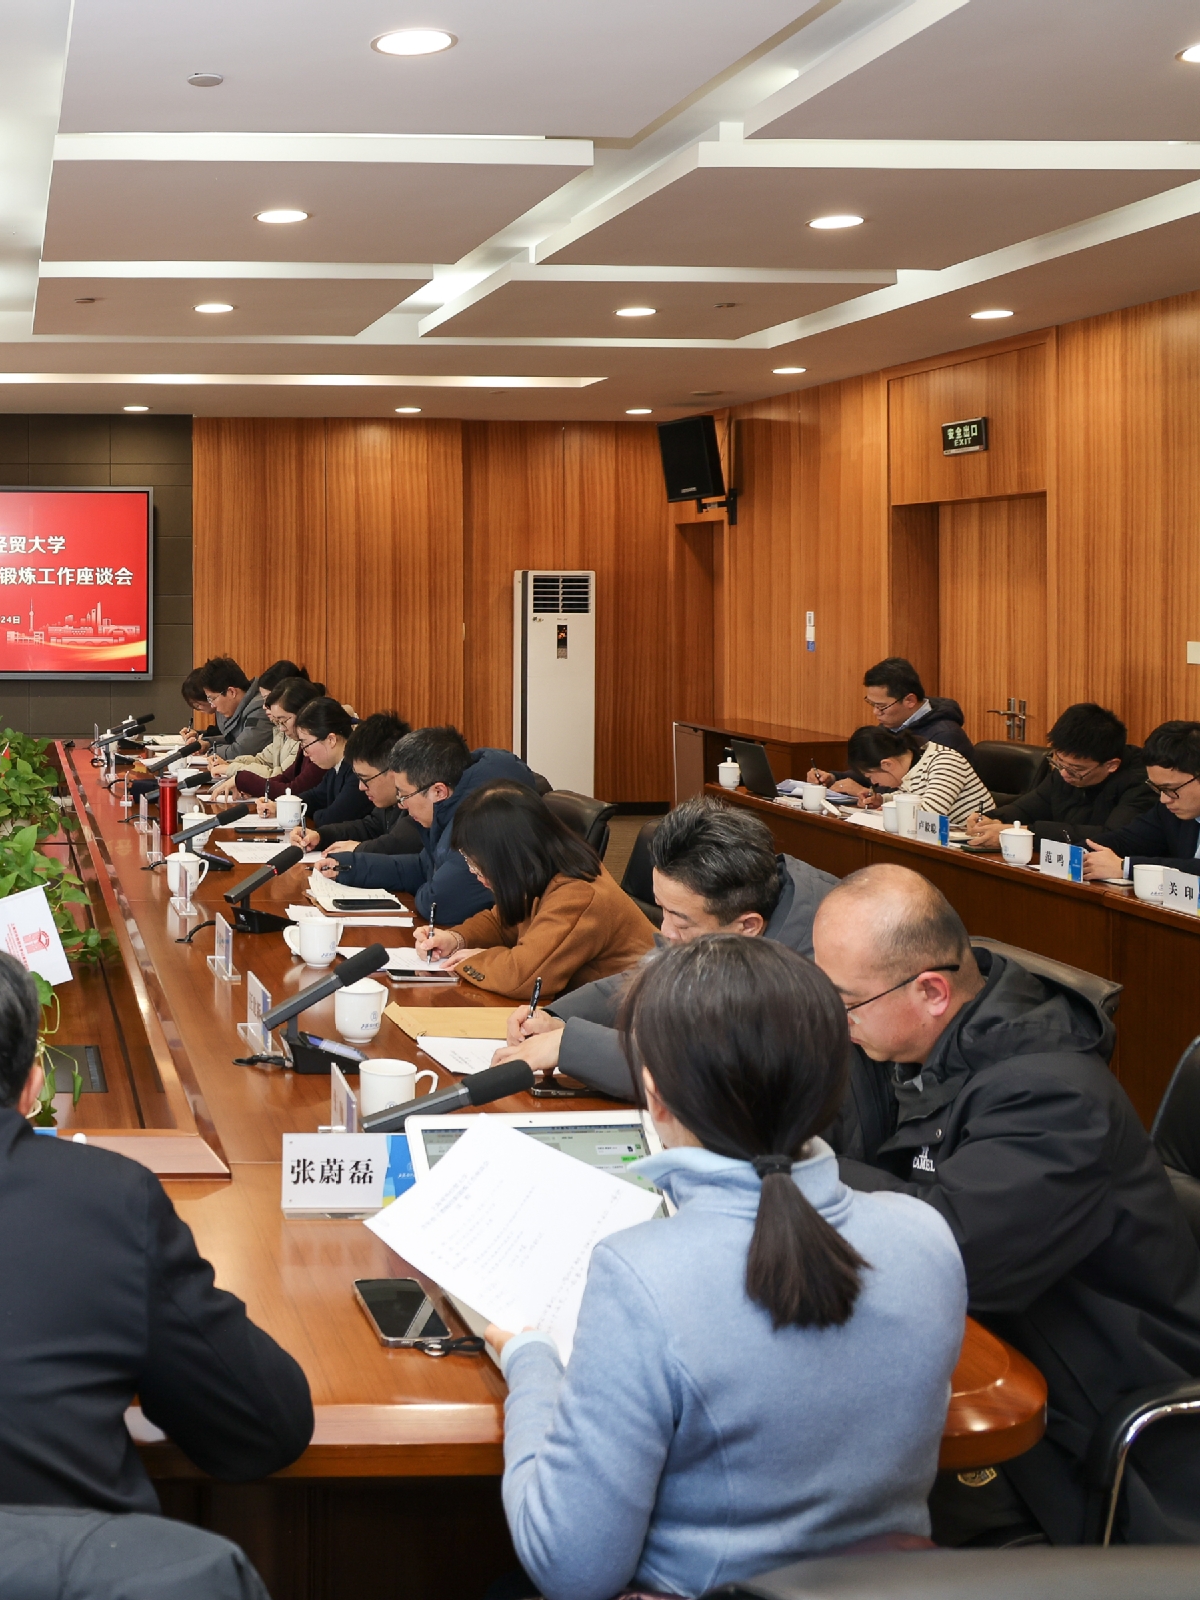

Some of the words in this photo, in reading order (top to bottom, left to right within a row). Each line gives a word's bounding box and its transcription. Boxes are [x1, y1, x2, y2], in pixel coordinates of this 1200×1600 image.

[947, 424, 978, 440] 安全出口
[954, 437, 972, 447] EXIT
[290, 1157, 374, 1185] 张蔚磊
[912, 1156, 936, 1172] CAMEL
